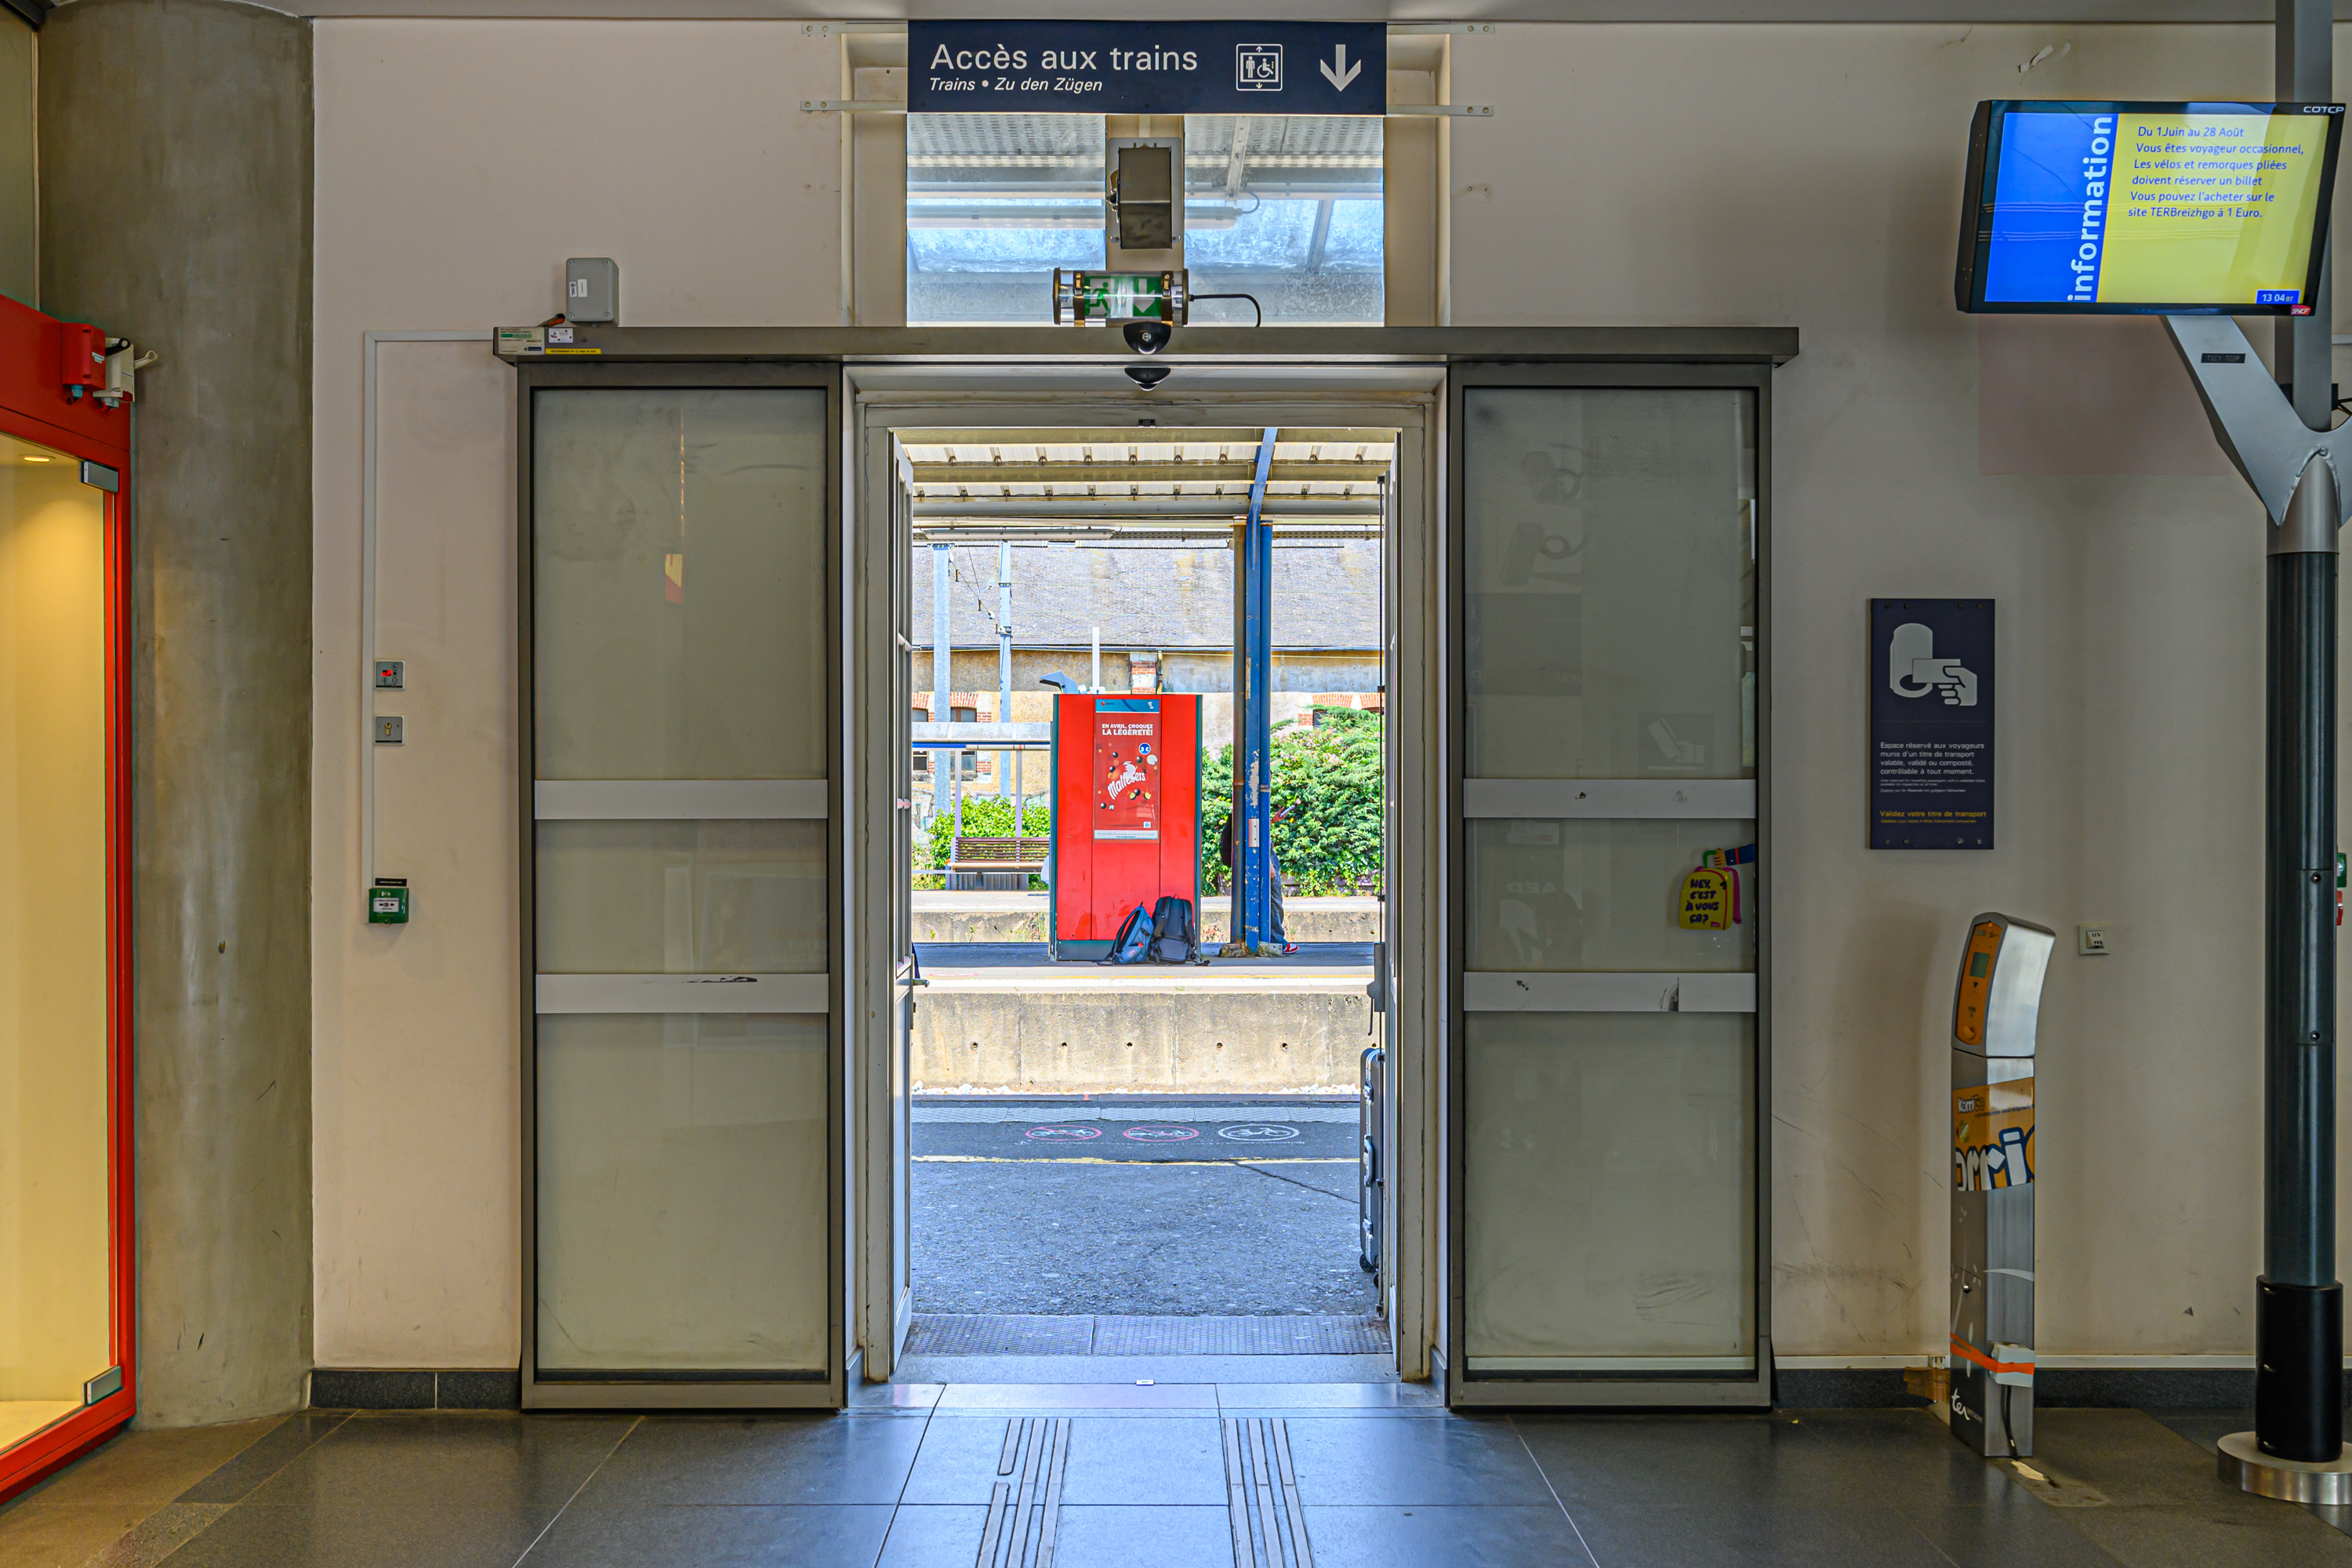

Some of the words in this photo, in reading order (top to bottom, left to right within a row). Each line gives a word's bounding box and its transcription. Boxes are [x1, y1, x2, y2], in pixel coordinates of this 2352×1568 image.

[930, 44, 1028, 70] Accès
[1041, 51, 1097, 70] aux
[1109, 45, 1198, 71] trains
[930, 78, 975, 91] Trains
[994, 78, 1014, 91] Zu
[1020, 78, 1048, 91] den
[1054, 78, 1102, 94] Zügen
[2138, 126, 2153, 136] Du
[2203, 127, 2216, 136] 28
[2219, 128, 2244, 137] Août
[2136, 143, 2161, 152] Vous
[2165, 143, 2187, 152] êtes
[2190, 146, 2237, 155] voyageur
[2239, 144, 2303, 155] occasionnel,
[2134, 159, 2151, 169] Les
[2154, 159, 2181, 169] vélos
[2198, 162, 2253, 171] remorques
[2256, 160, 2287, 172] pliées
[2132, 176, 2171, 185] doivent
[2175, 176, 2216, 185] réserver
[2235, 176, 2263, 185] billet
[2130, 191, 2155, 201] Vous
[2158, 193, 2195, 203] pouvez
[2198, 192, 2243, 201] l'acheter
[2246, 193, 2262, 201] sur
[2265, 192, 2274, 201] le
[2067, 117, 2112, 302] information
[2128, 208, 2147, 216] site
[2151, 208, 2215, 219] TERBreizhgo
[2218, 208, 2223, 216] à
[2227, 208, 2232, 216] 1
[2236, 208, 2263, 217] Euro.
[1690, 891, 1716, 899] C'EST
[1686, 900, 1693, 912] À
[1695, 902, 1719, 911] VOUS
[1690, 913, 1708, 924] ÇA?
[1951, 1388, 1970, 1421] ter
